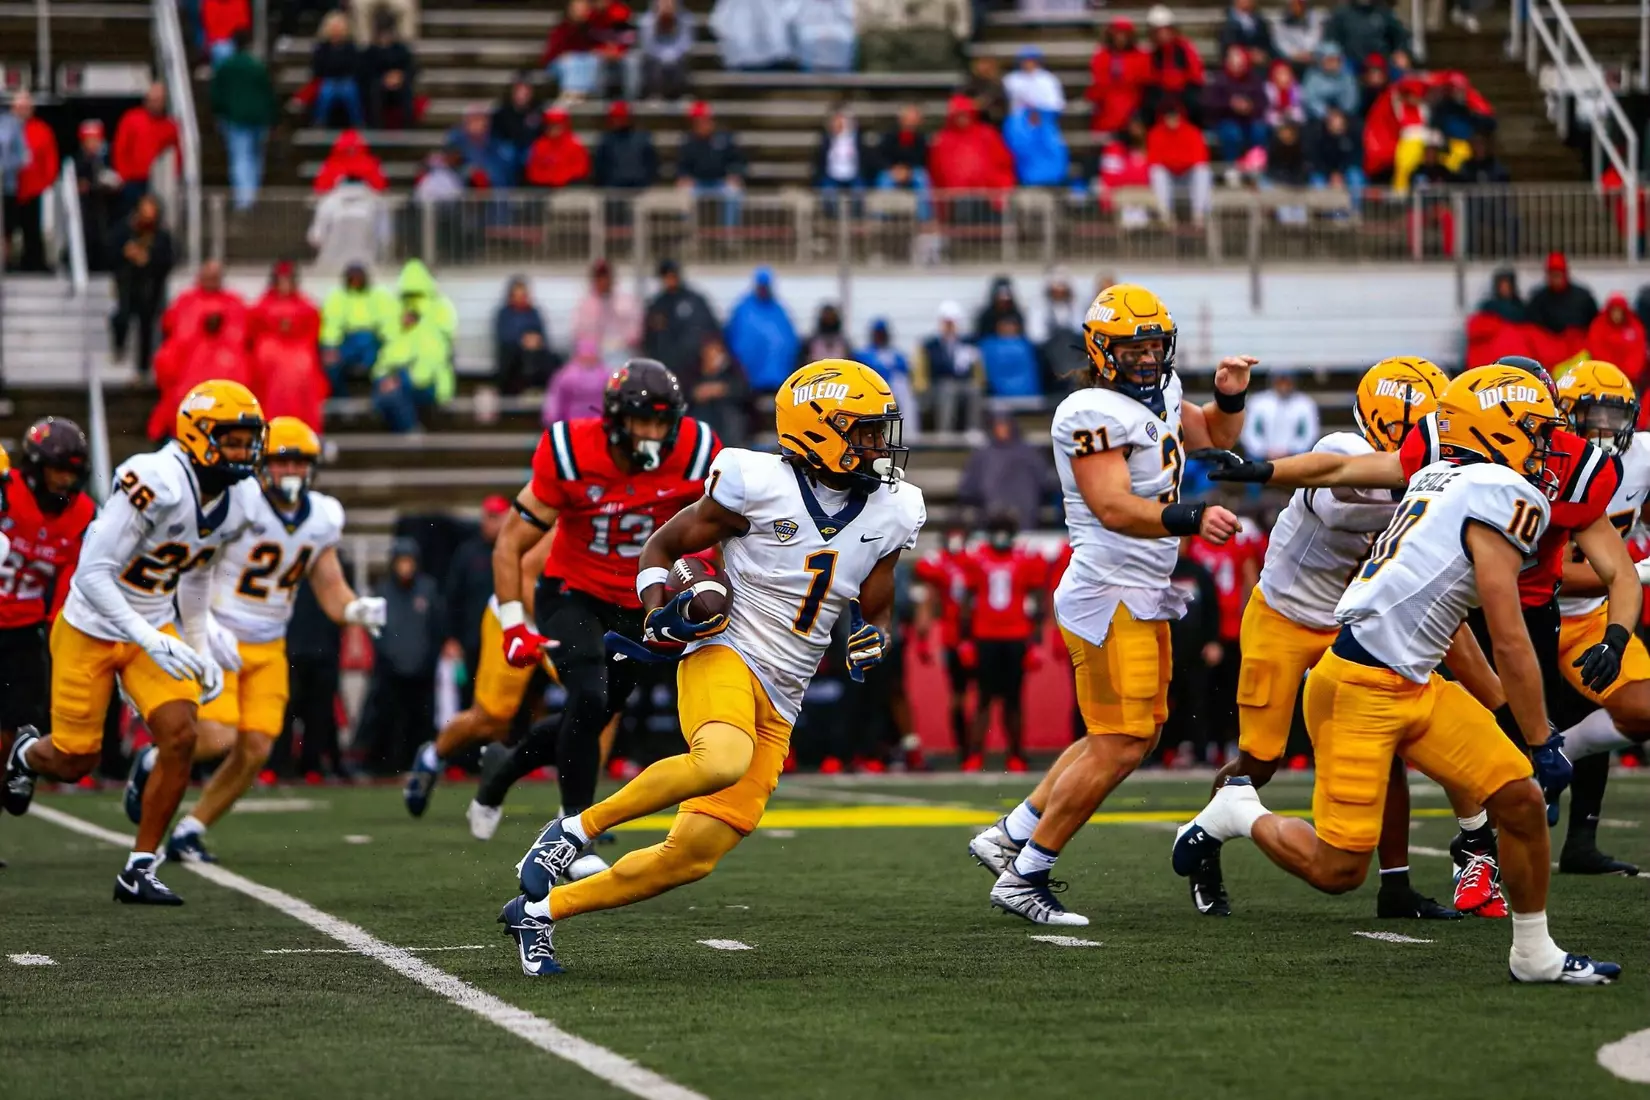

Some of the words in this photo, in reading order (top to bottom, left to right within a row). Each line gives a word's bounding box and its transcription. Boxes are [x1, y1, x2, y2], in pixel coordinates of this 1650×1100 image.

[792, 382, 850, 407] TOLEDO
[1474, 385, 1539, 411] TOLEDO
[1072, 425, 1109, 457] 31
[709, 469, 721, 499] 1
[1157, 424, 1184, 504] 3
[120, 470, 155, 512] 26
[588, 514, 654, 557] 13
[1506, 498, 1542, 544] 10
[234, 541, 317, 602] 24
[792, 550, 839, 637] 1
